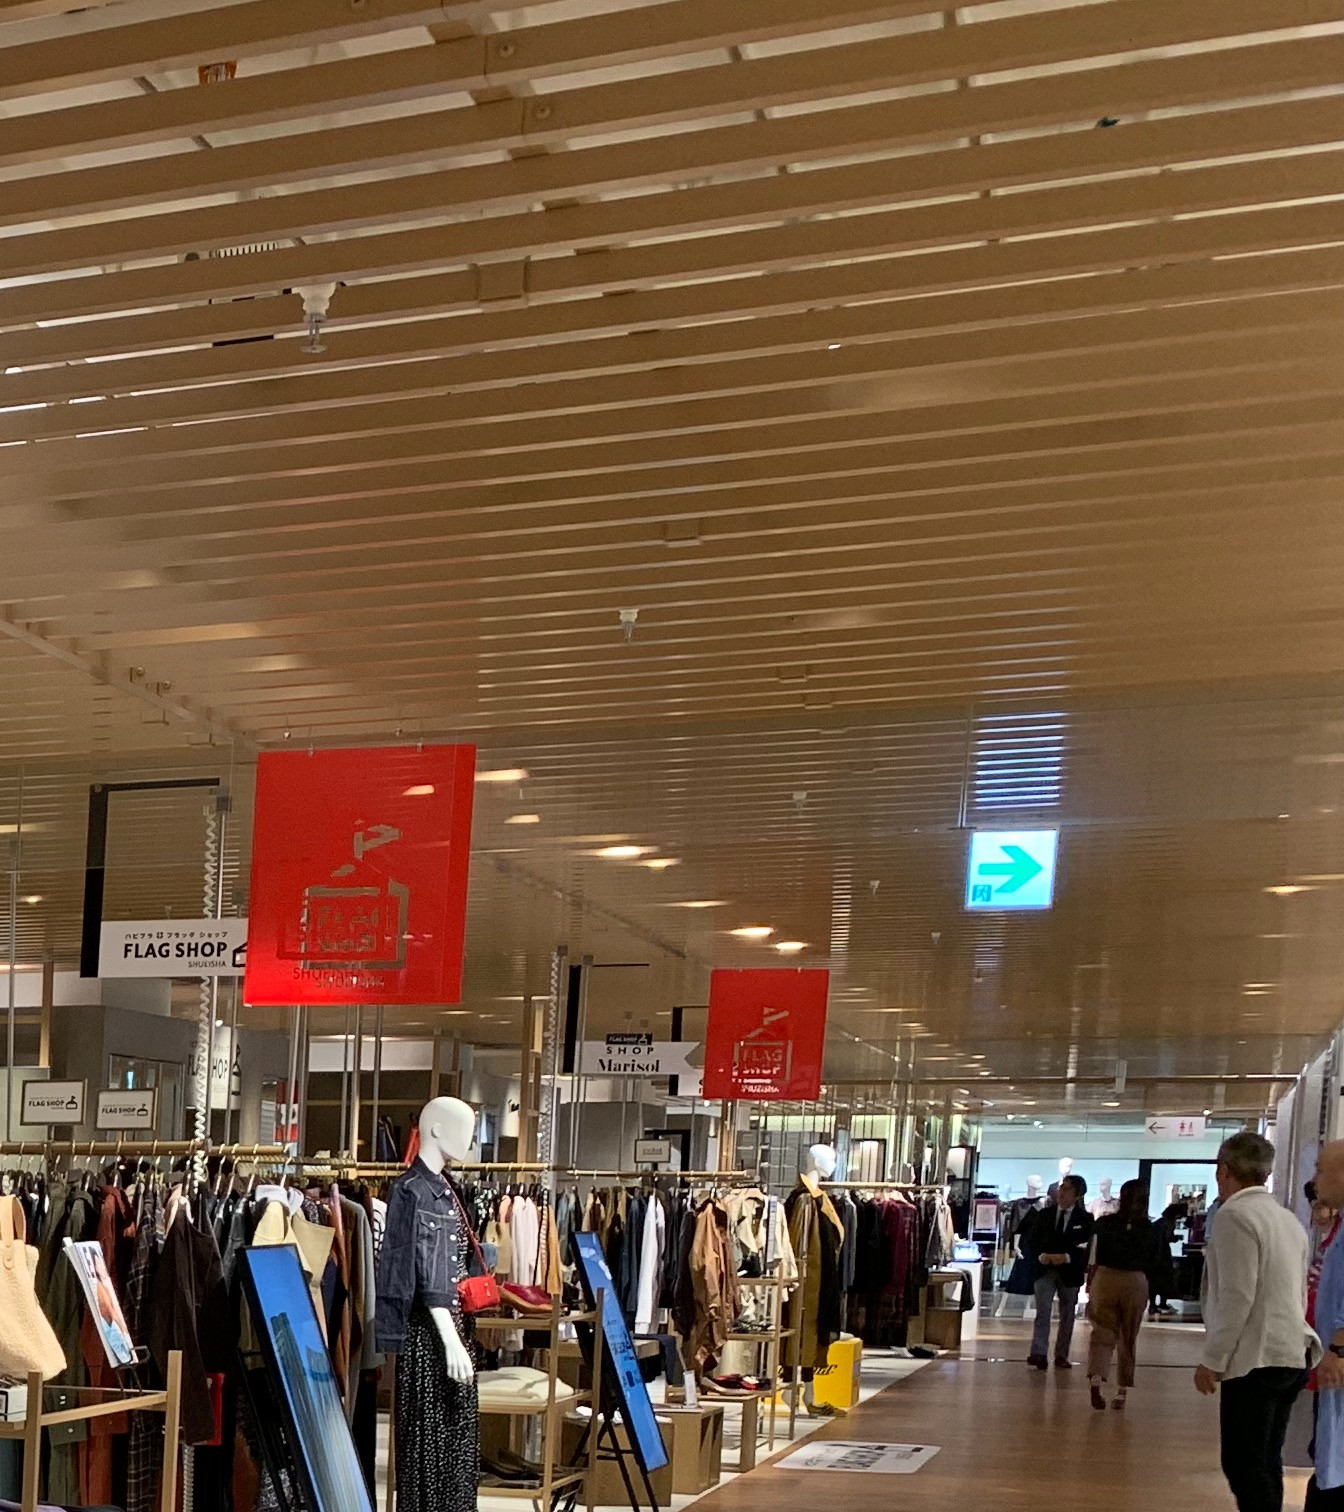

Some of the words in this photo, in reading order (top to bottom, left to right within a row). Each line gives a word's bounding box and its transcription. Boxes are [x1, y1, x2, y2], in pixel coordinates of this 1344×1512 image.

[123, 942, 171, 959] FLAG
[175, 941, 228, 958] SHOP
[606, 1046, 654, 1055] SHOP
[598, 1058, 660, 1072] Marisol
